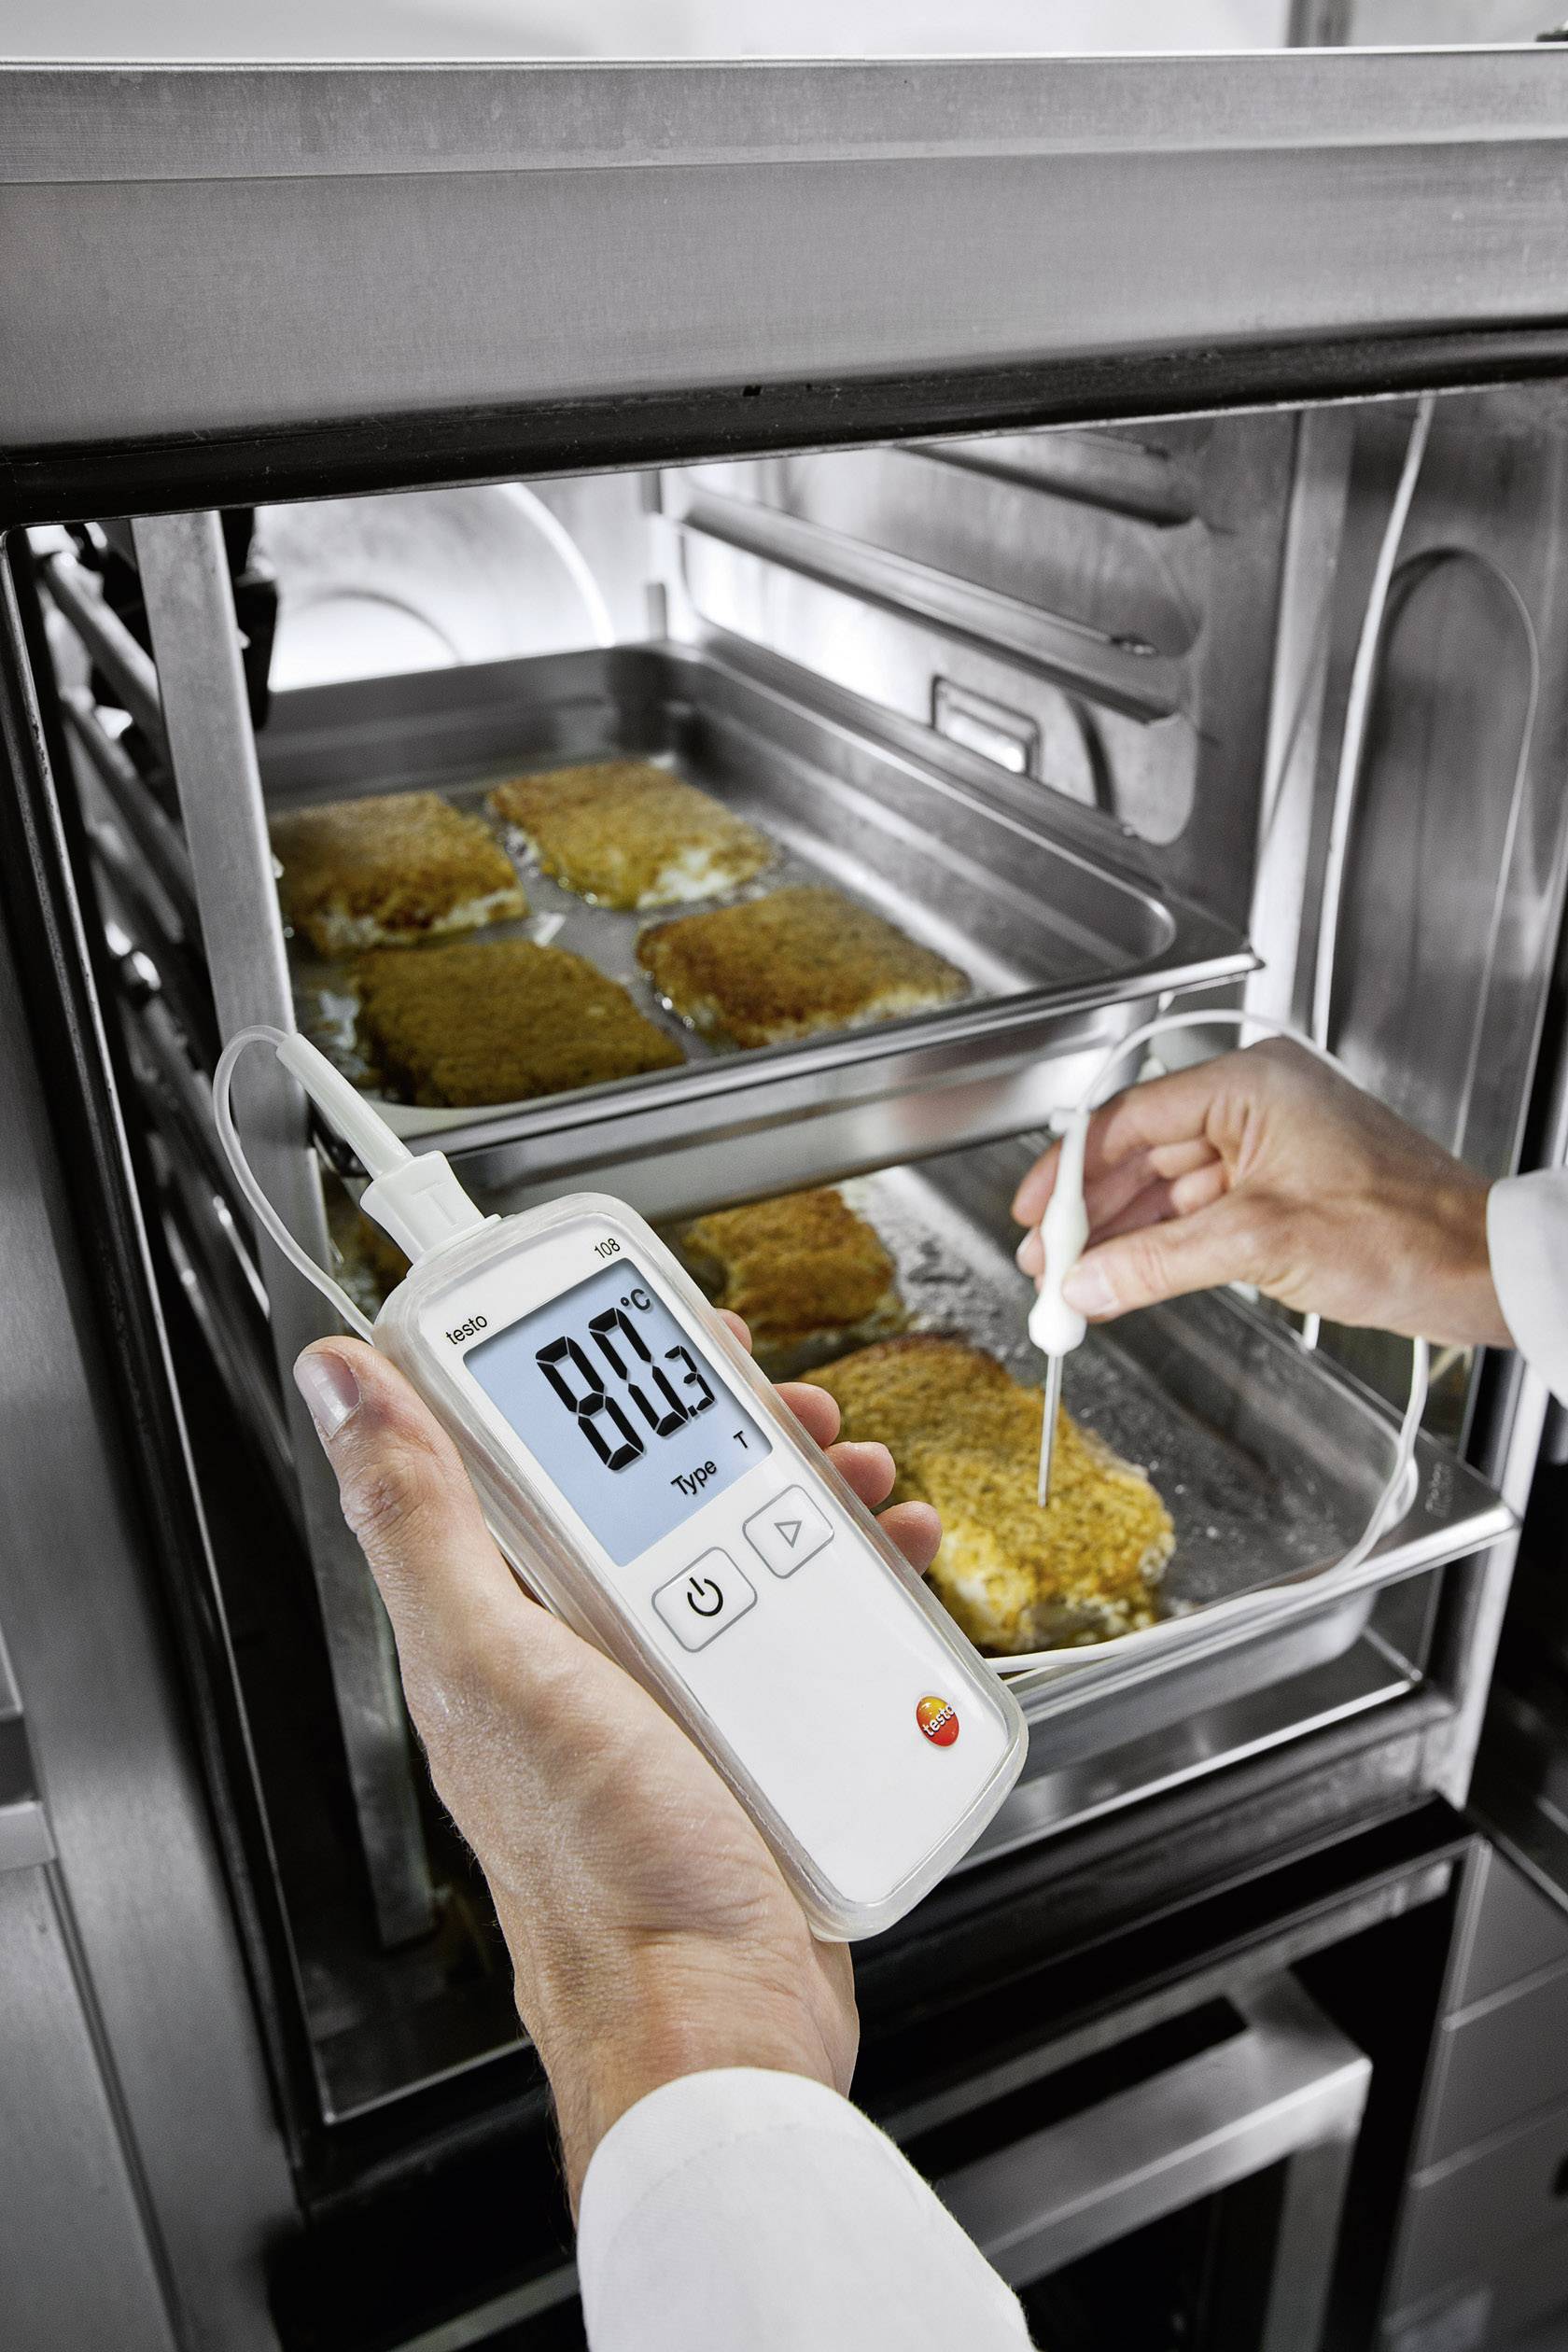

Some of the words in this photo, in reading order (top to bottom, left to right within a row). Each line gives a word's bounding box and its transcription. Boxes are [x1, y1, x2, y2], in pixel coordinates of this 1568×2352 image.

[445, 1315, 488, 1345] testo
[594, 1238, 621, 1262] 108
[620, 1288, 651, 1311] °C
[670, 1461, 718, 1495] Type
[733, 1430, 749, 1449] T
[921, 1703, 956, 1737] testo
